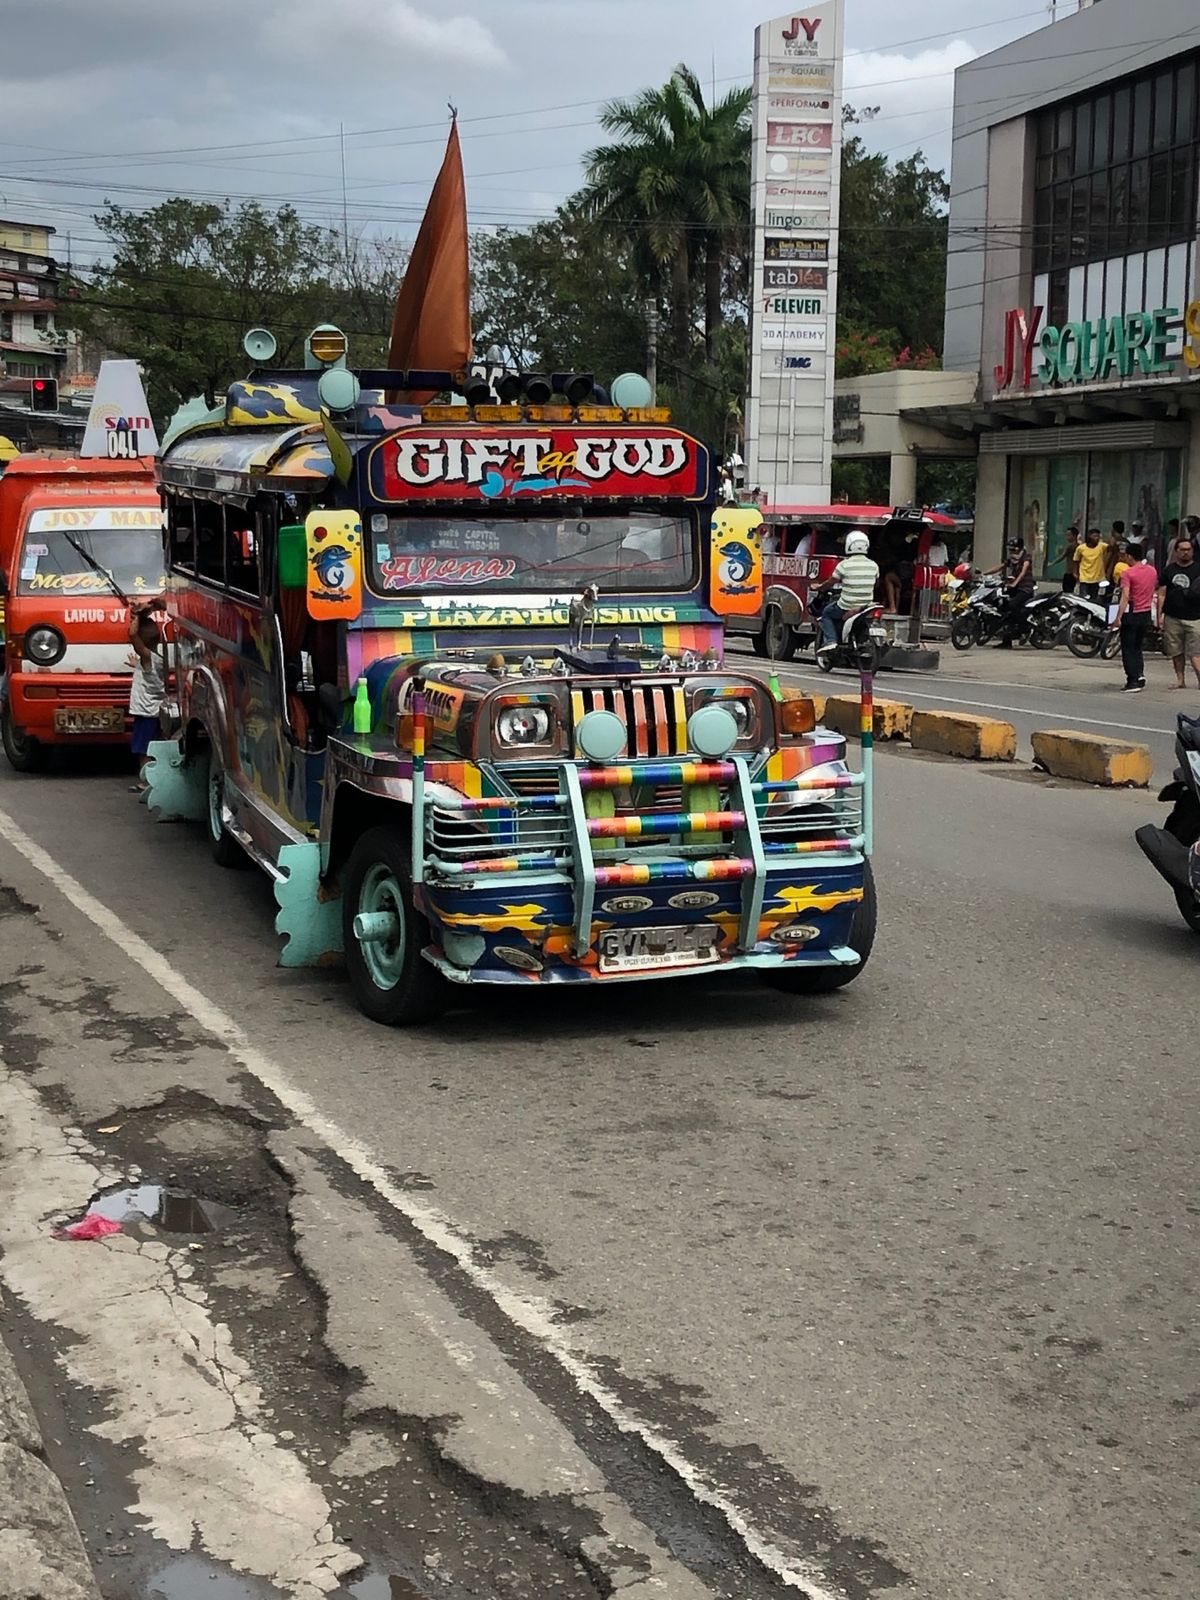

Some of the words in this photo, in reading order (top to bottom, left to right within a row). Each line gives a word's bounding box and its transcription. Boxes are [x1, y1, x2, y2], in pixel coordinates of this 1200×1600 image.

[782, 17, 822, 41] JY
[791, 67, 826, 76] SQUARE
[775, 126, 823, 145] LBC
[776, 331, 825, 340] ACADEMY
[993, 305, 1044, 391] JY
[1037, 307, 1179, 384] SQUARE
[108, 430, 138, 459] 04L
[397, 437, 552, 484] GIFT
[574, 438, 687, 479] GOD
[44, 511, 98, 528] JOY
[778, 557, 804, 575] CARBON
[64, 608, 105, 624] LAHUG
[109, 608, 127, 623] JY
